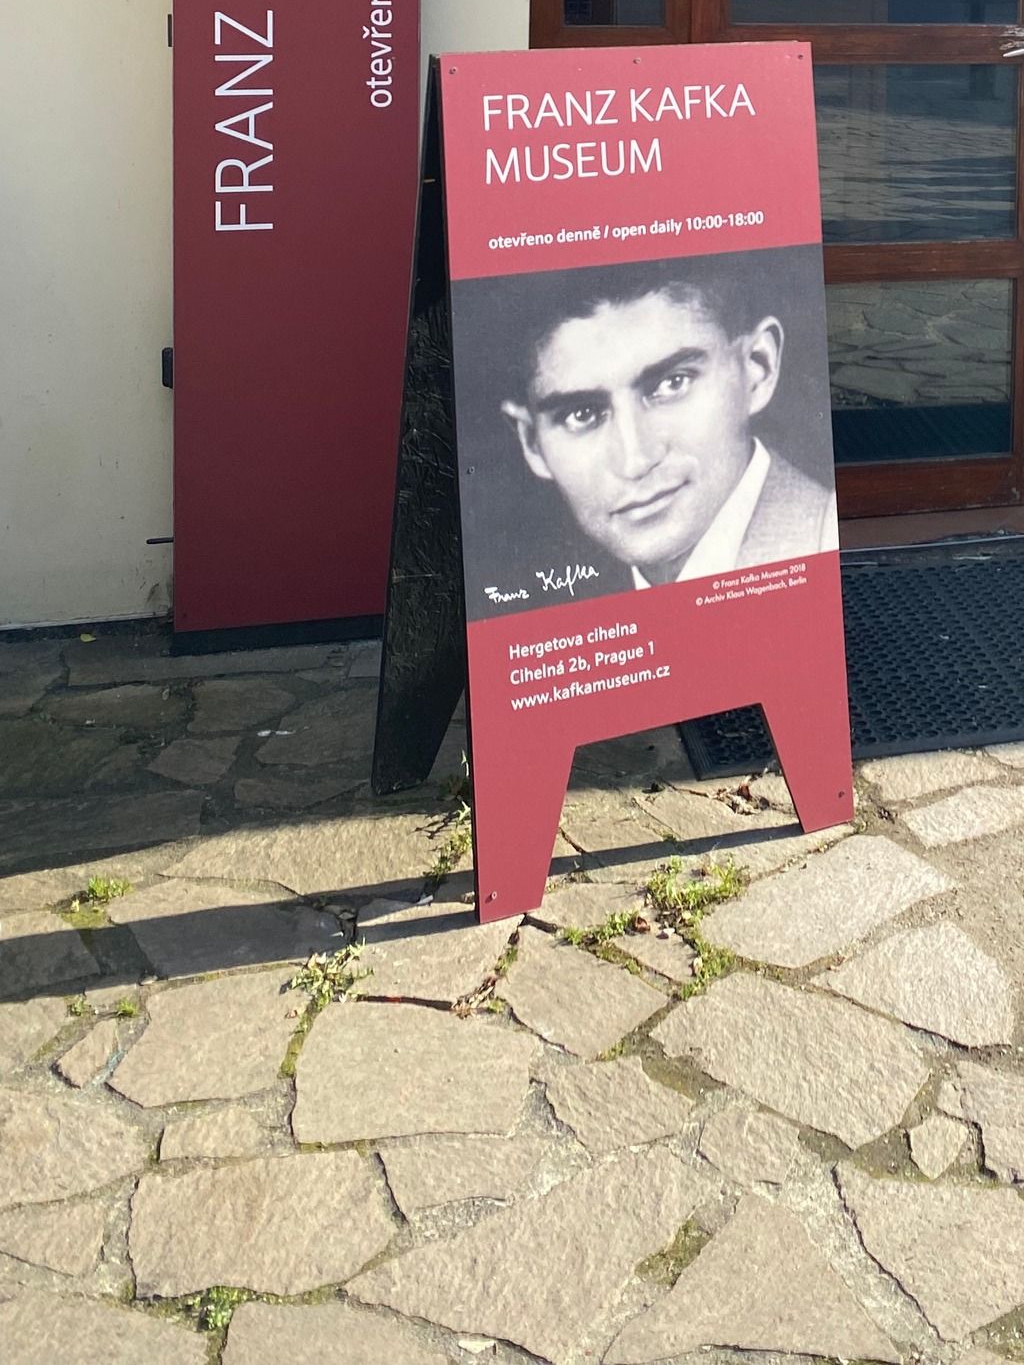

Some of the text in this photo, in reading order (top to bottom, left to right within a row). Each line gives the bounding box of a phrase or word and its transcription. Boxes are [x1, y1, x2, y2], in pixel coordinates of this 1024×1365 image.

[213, 9, 275, 232] FRANZ
[482, 82, 757, 132] FRANZ KAFKA
[485, 137, 663, 186] MUSEUM
[487, 229, 554, 250] otevřeno
[556, 224, 602, 244] denně
[612, 223, 647, 242] open
[649, 218, 683, 236] daily
[685, 210, 765, 231] 10:00-18:00
[484, 563, 600, 604] Franz Kafka
[704, 593, 726, 605] Archiv
[726, 589, 745, 600] Klaus
[745, 579, 788, 596] Wagenbach,
[788, 575, 808, 587] Berlin
[720, 578, 740, 588] Franz
[740, 573, 760, 585] Kafka
[760, 568, 789, 580] Museum
[789, 562, 807, 574] 2018
[508, 621, 638, 660] Hergetova cihelna
[509, 640, 656, 686] Cihelná 2b, Prague 1
[510, 664, 671, 711] www.kafkamuseum.cz
